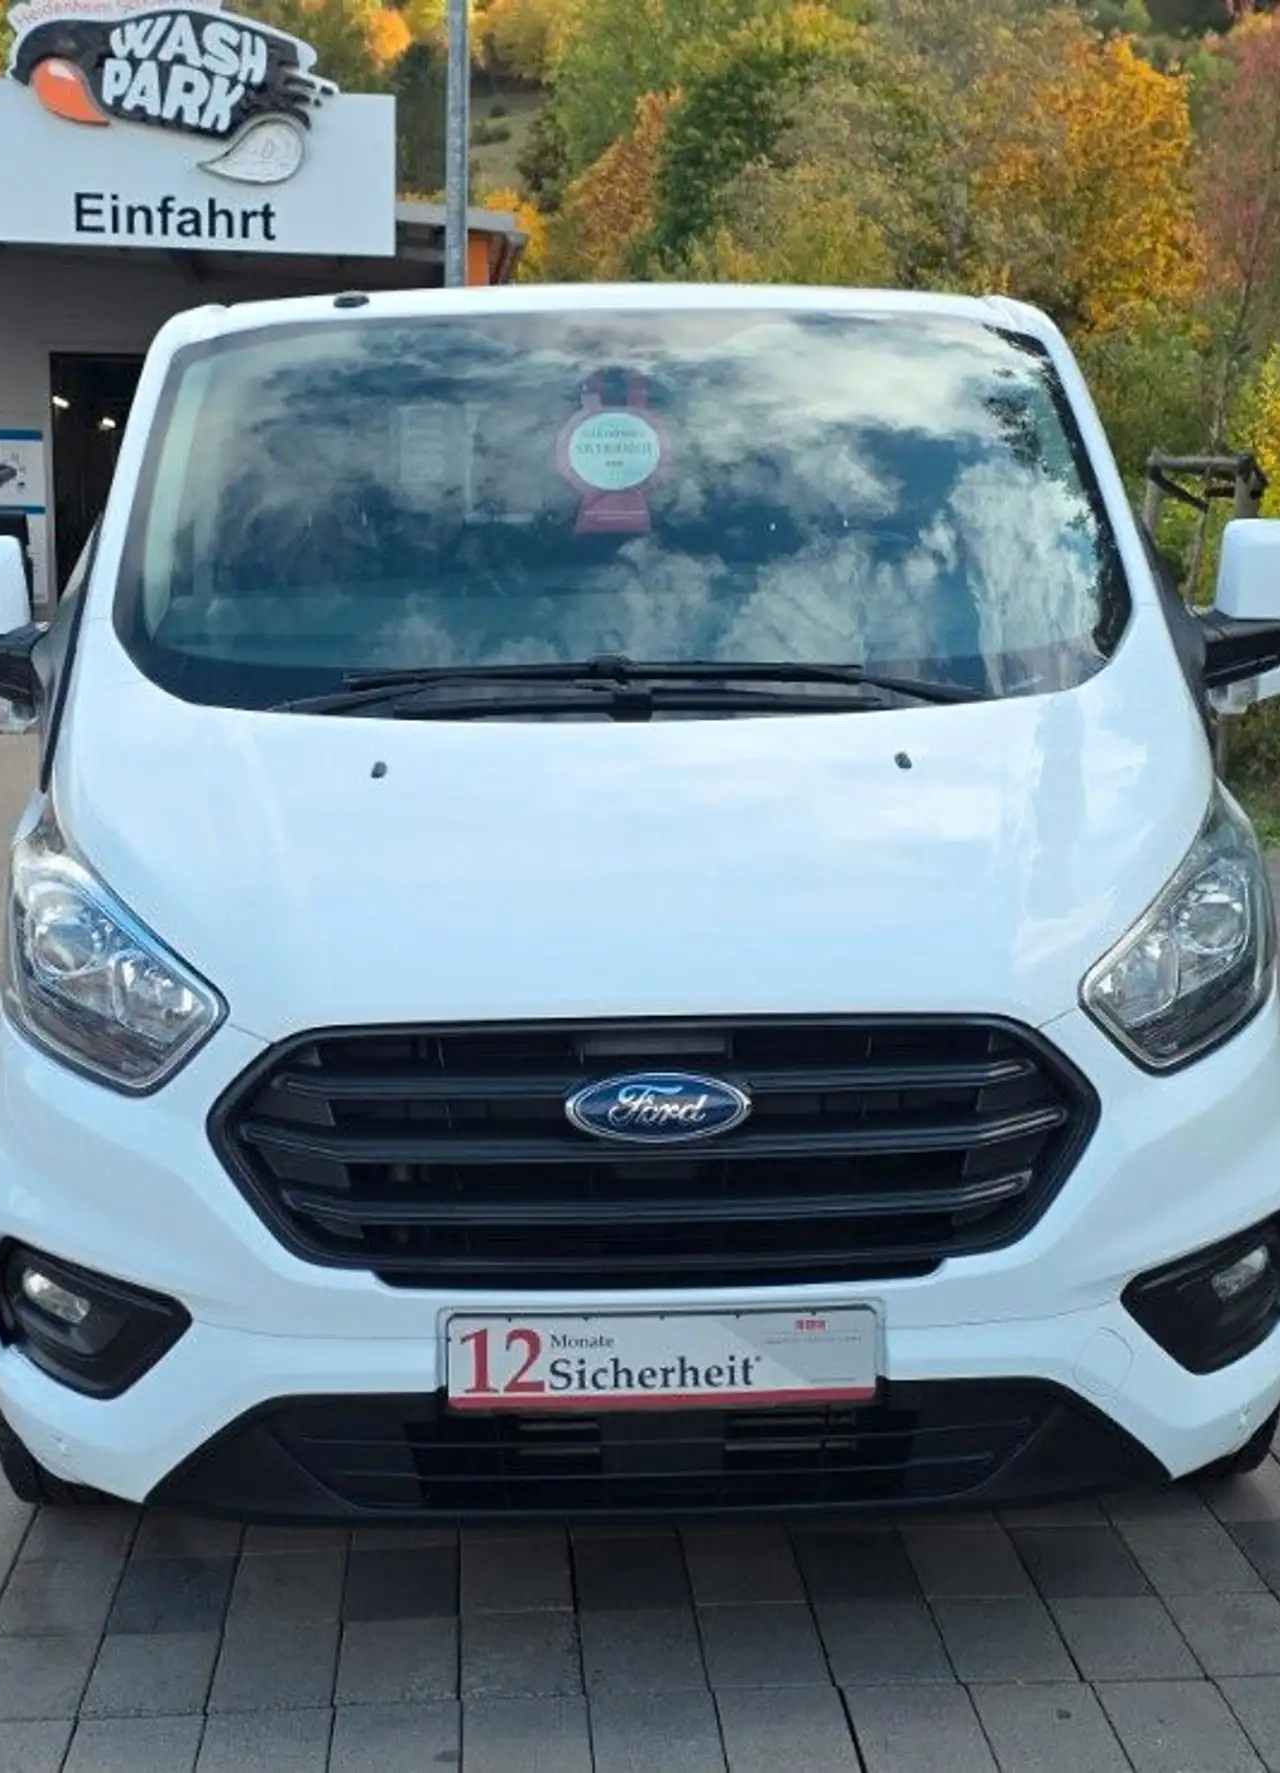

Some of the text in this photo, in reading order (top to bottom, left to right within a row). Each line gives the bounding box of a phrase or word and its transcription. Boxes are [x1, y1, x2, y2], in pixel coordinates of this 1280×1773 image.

[110, 14, 267, 86] WASH
[102, 57, 246, 132] PARK
[74, 192, 276, 241] Einfahrt
[608, 1084, 709, 1127] Ford
[460, 1327, 615, 1394] 12 Monate
